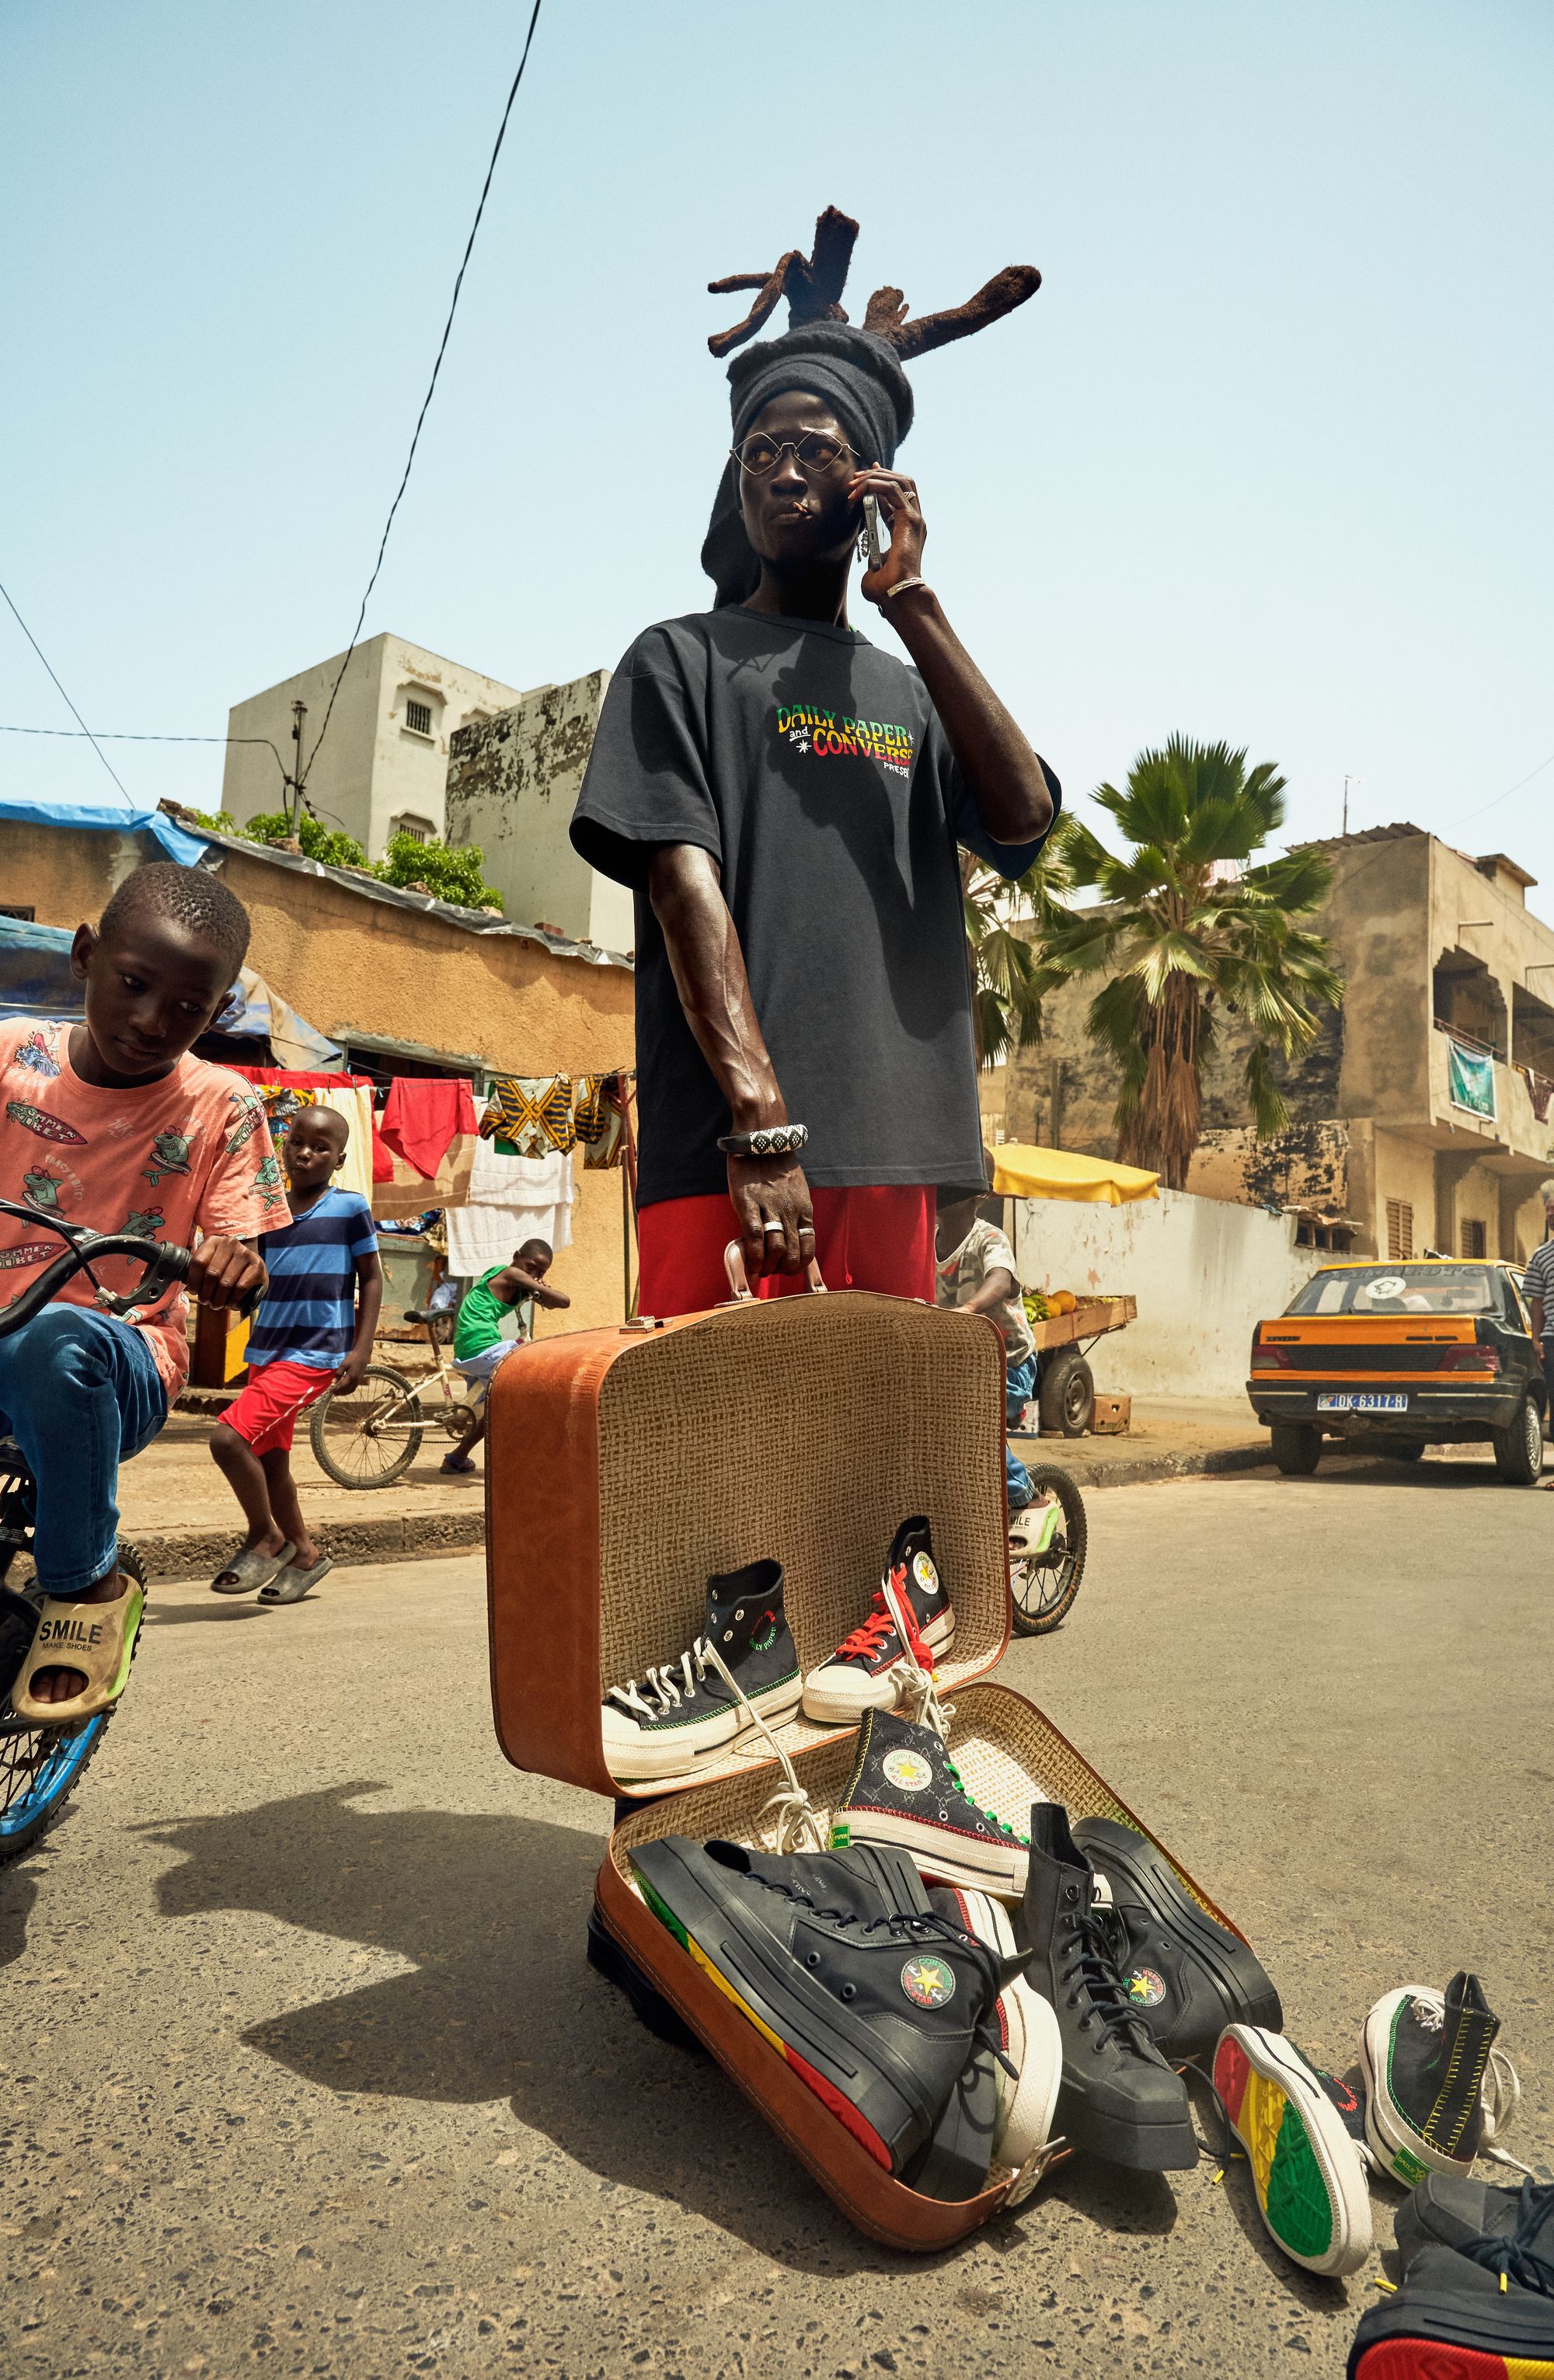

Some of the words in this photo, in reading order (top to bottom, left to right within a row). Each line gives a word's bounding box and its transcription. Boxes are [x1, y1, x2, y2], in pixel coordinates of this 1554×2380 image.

[777, 705, 836, 734] DAILY
[842, 716, 909, 747] PAPER
[789, 727, 809, 738] and
[813, 729, 913, 766] CONVERSE
[883, 761, 909, 779] PRESE
[16, 1106, 76, 1139] SUMMER
[0, 1245, 54, 1258] UMMER
[0, 1250, 51, 1267] IBES
[1338, 1394, 1354, 1407] DK
[1358, 1394, 1390, 1408] 6317
[1009, 1516, 1031, 1526] MILE
[40, 1619, 103, 1644] SMILE
[42, 1641, 64, 1650] MAKE
[66, 1642, 92, 1652] SHOES
[918, 1958, 951, 1989] CONVERSE
[911, 1990, 933, 2005] STAR
